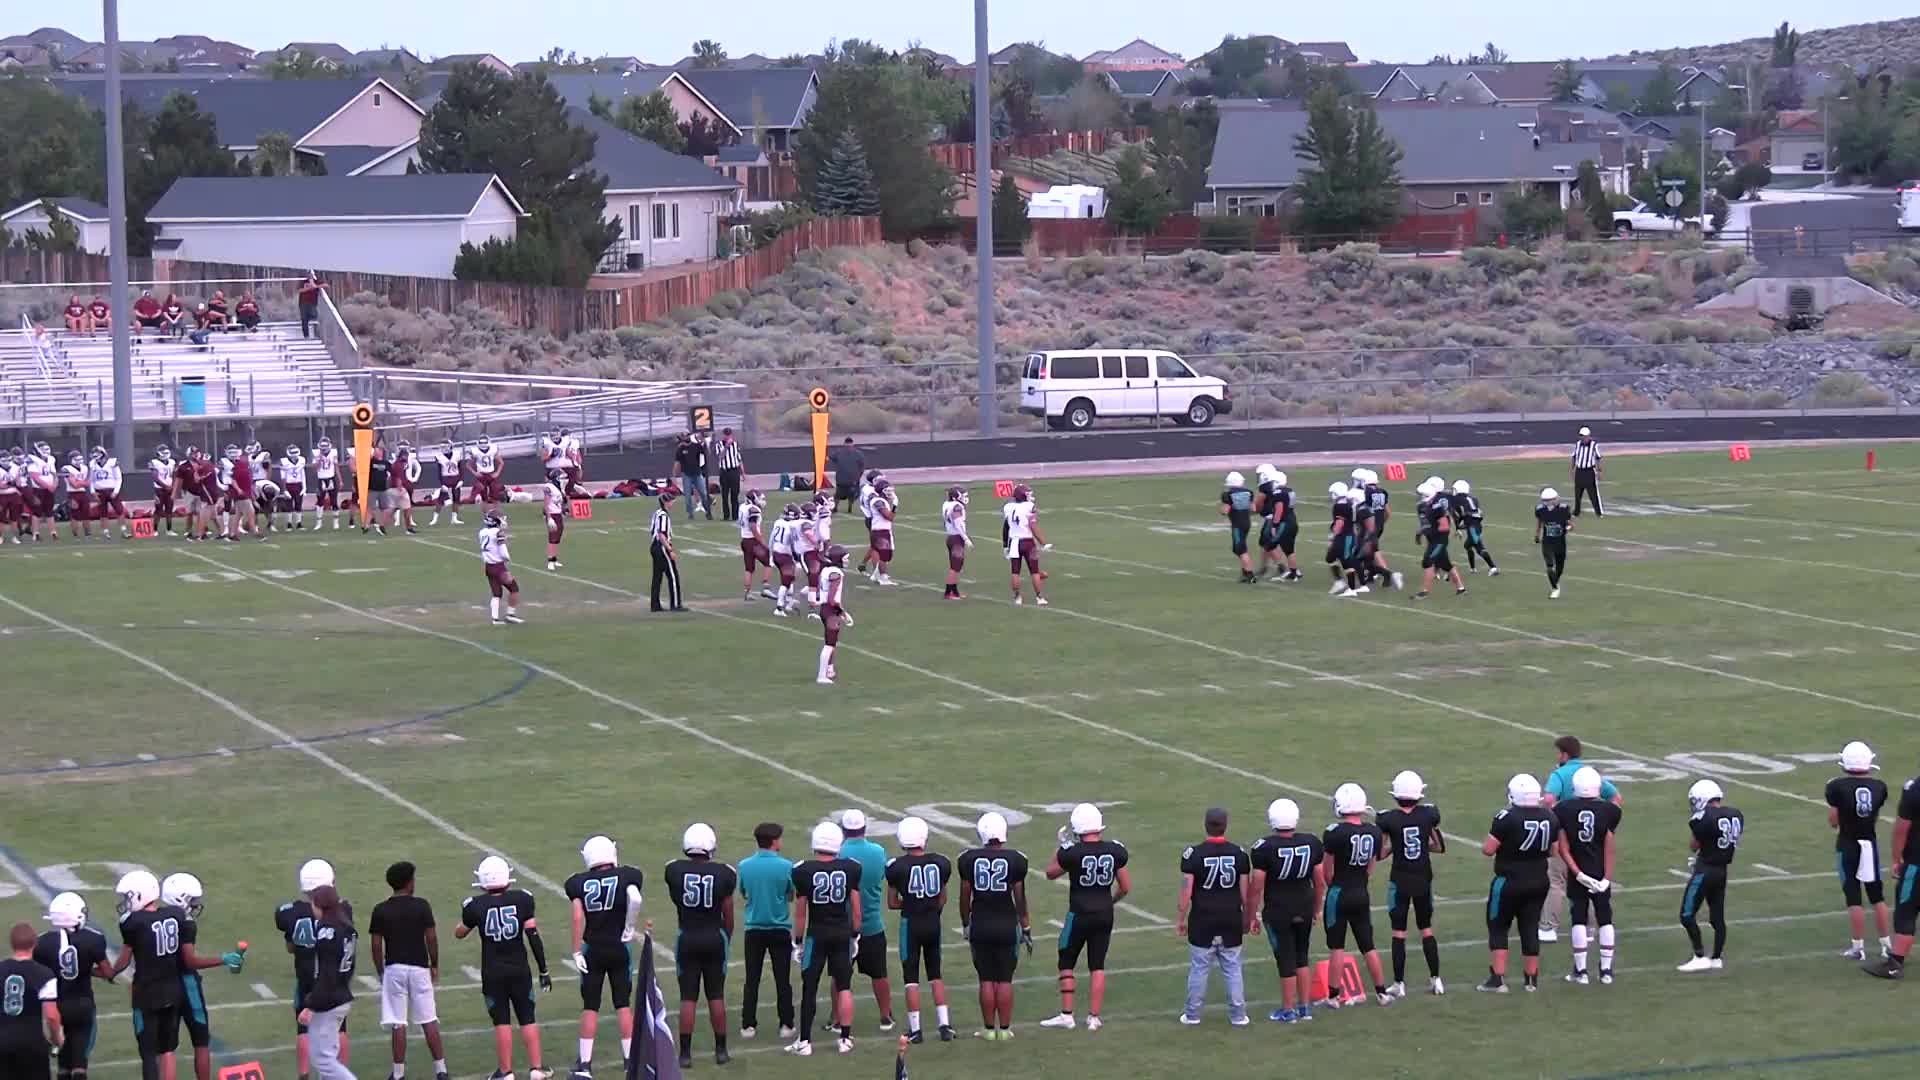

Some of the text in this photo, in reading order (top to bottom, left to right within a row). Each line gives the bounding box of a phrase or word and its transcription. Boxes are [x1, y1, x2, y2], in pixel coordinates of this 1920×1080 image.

[694, 408, 711, 430] 2
[998, 483, 1013, 497] 20
[574, 503, 590, 517] 30
[135, 521, 151, 535] 40
[773, 525, 785, 544] 21
[1855, 787, 1873, 818] 8
[1519, 820, 1550, 852] 71
[1578, 810, 1595, 842] 3
[1349, 834, 1374, 866] 19
[1403, 827, 1421, 860] 5
[974, 857, 1008, 892] 62
[1079, 854, 1115, 887] 33
[1203, 855, 1236, 889] 75
[1277, 845, 1311, 879] 77
[583, 876, 619, 912] 27
[682, 873, 715, 909] 51
[812, 870, 846, 904] 28
[908, 863, 941, 898] 40
[151, 917, 179, 957] 18
[484, 905, 519, 942] 45
[59, 945, 79, 980] 9
[3, 974, 25, 1016] 8
